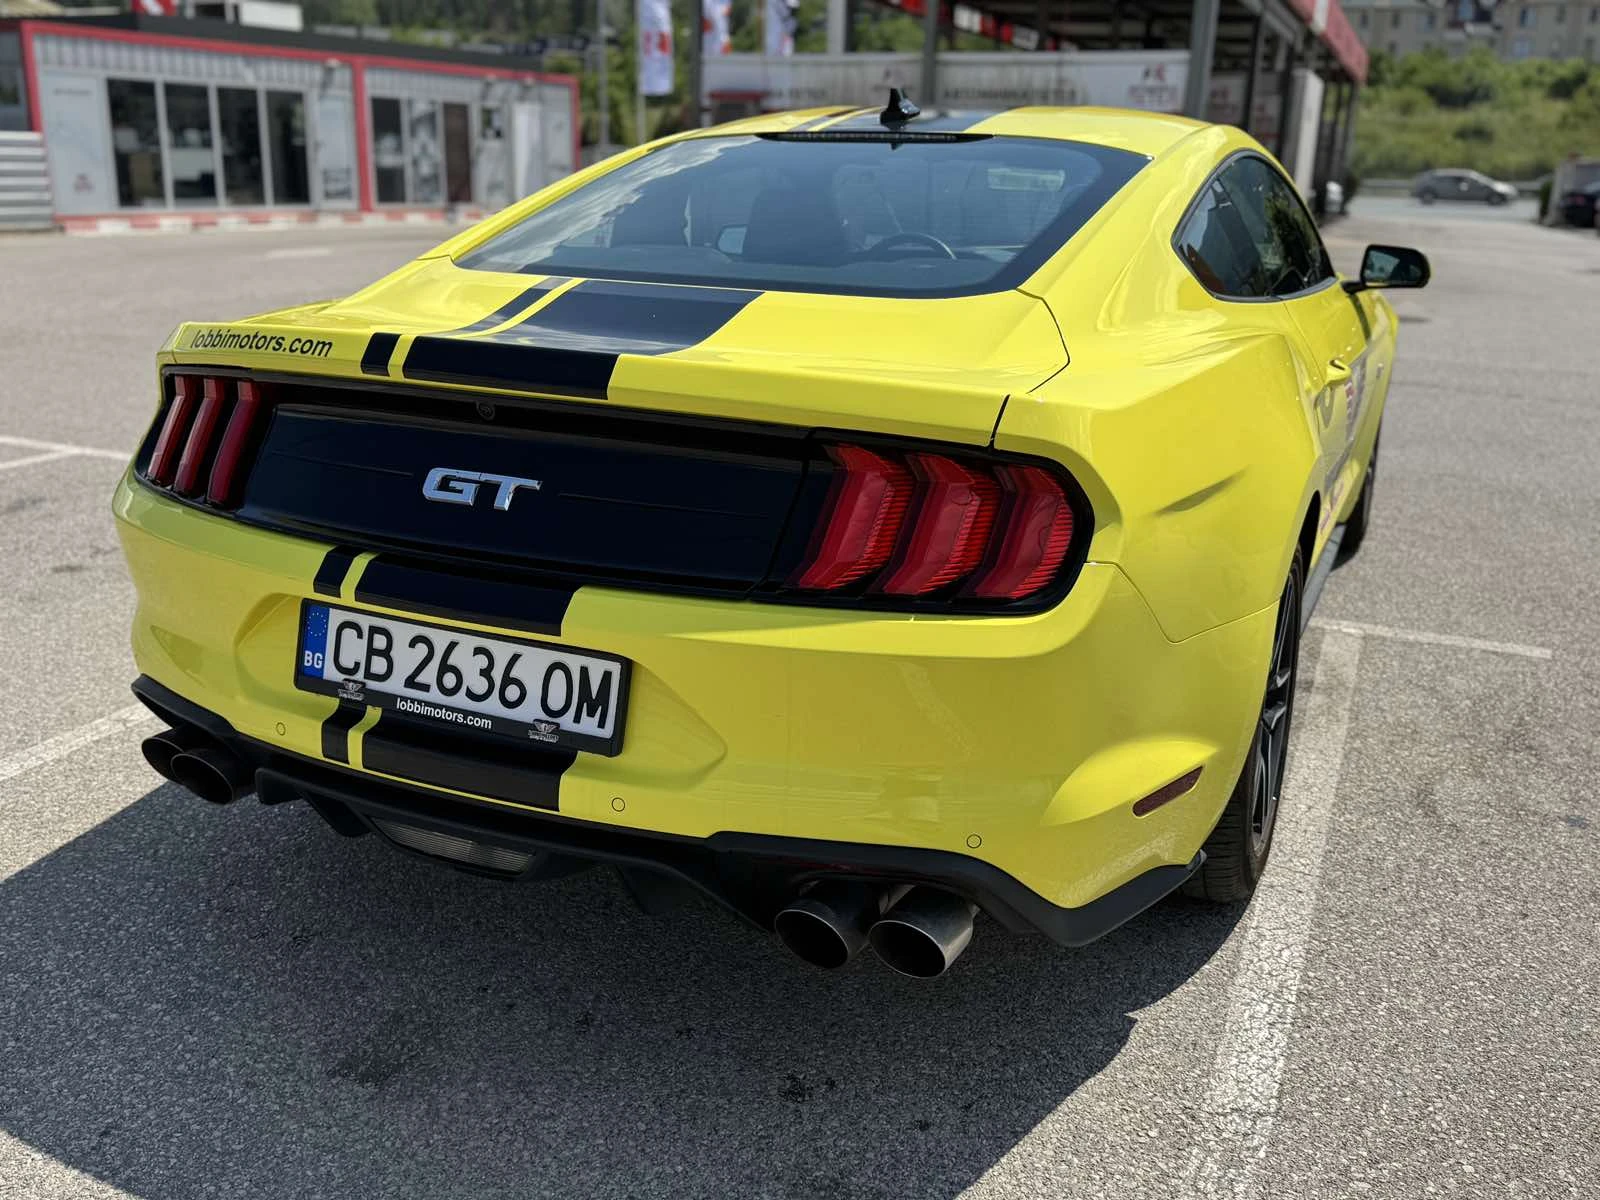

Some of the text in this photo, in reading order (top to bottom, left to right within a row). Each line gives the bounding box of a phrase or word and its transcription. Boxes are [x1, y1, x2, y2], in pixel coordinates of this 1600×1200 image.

[190, 329, 333, 357] lobbimotors.com
[422, 467, 543, 511] GT
[303, 650, 323, 669] BG
[332, 620, 613, 730] CB 2636 OM
[396, 697, 492, 729] lobbimotors.com
